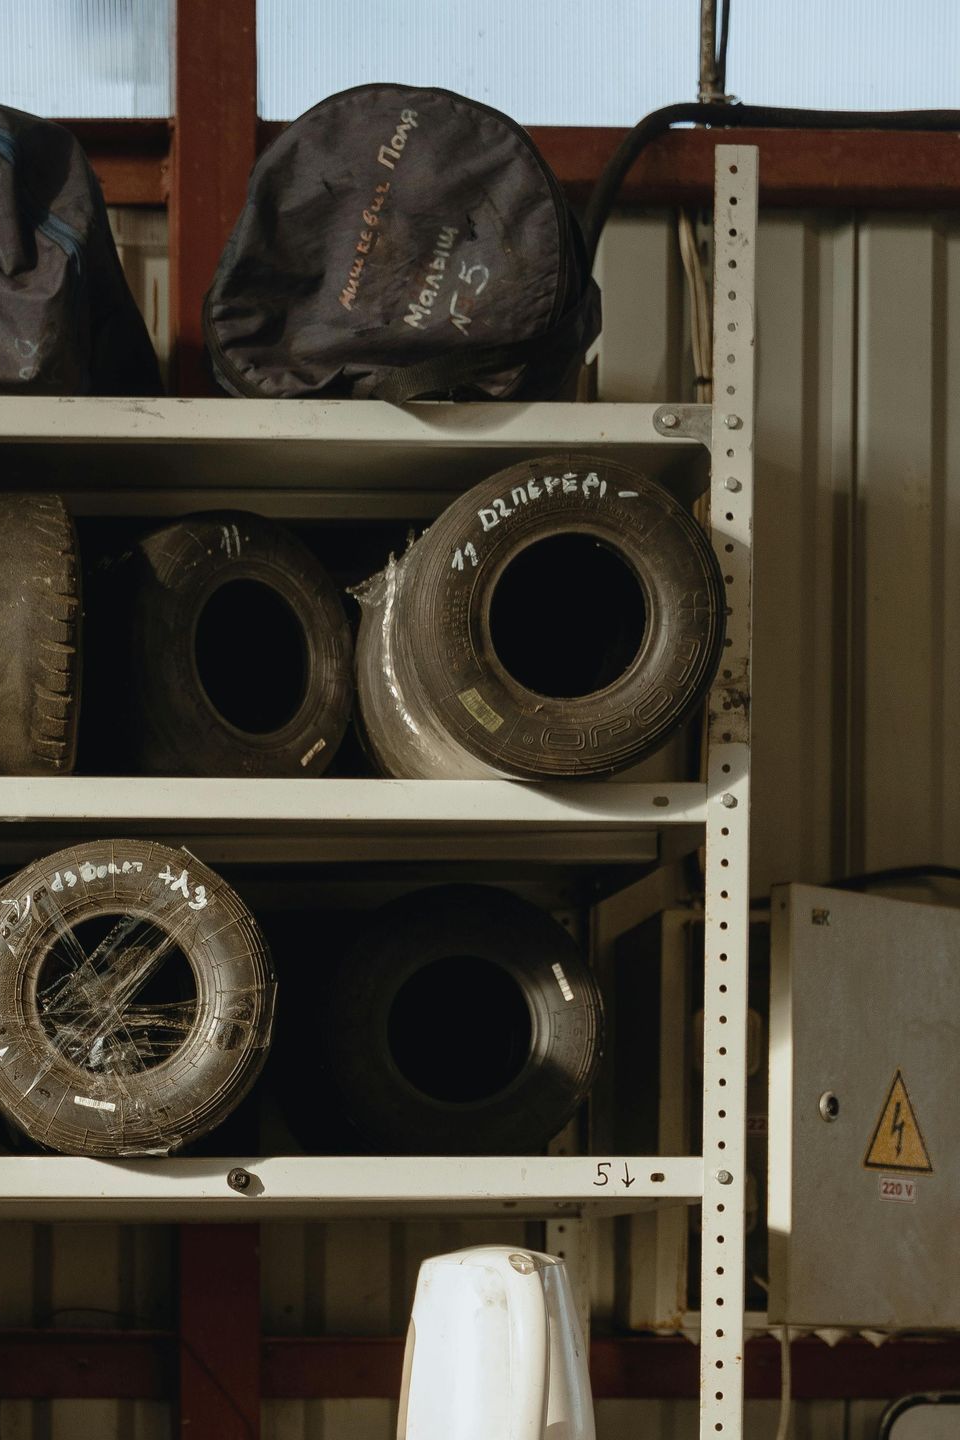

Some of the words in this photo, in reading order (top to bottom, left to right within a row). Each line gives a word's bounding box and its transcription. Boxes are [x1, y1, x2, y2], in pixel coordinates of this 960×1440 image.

[593, 1162, 612, 1186] 5
[882, 1182, 902, 1196] 220
[905, 1184, 913, 1197] V
